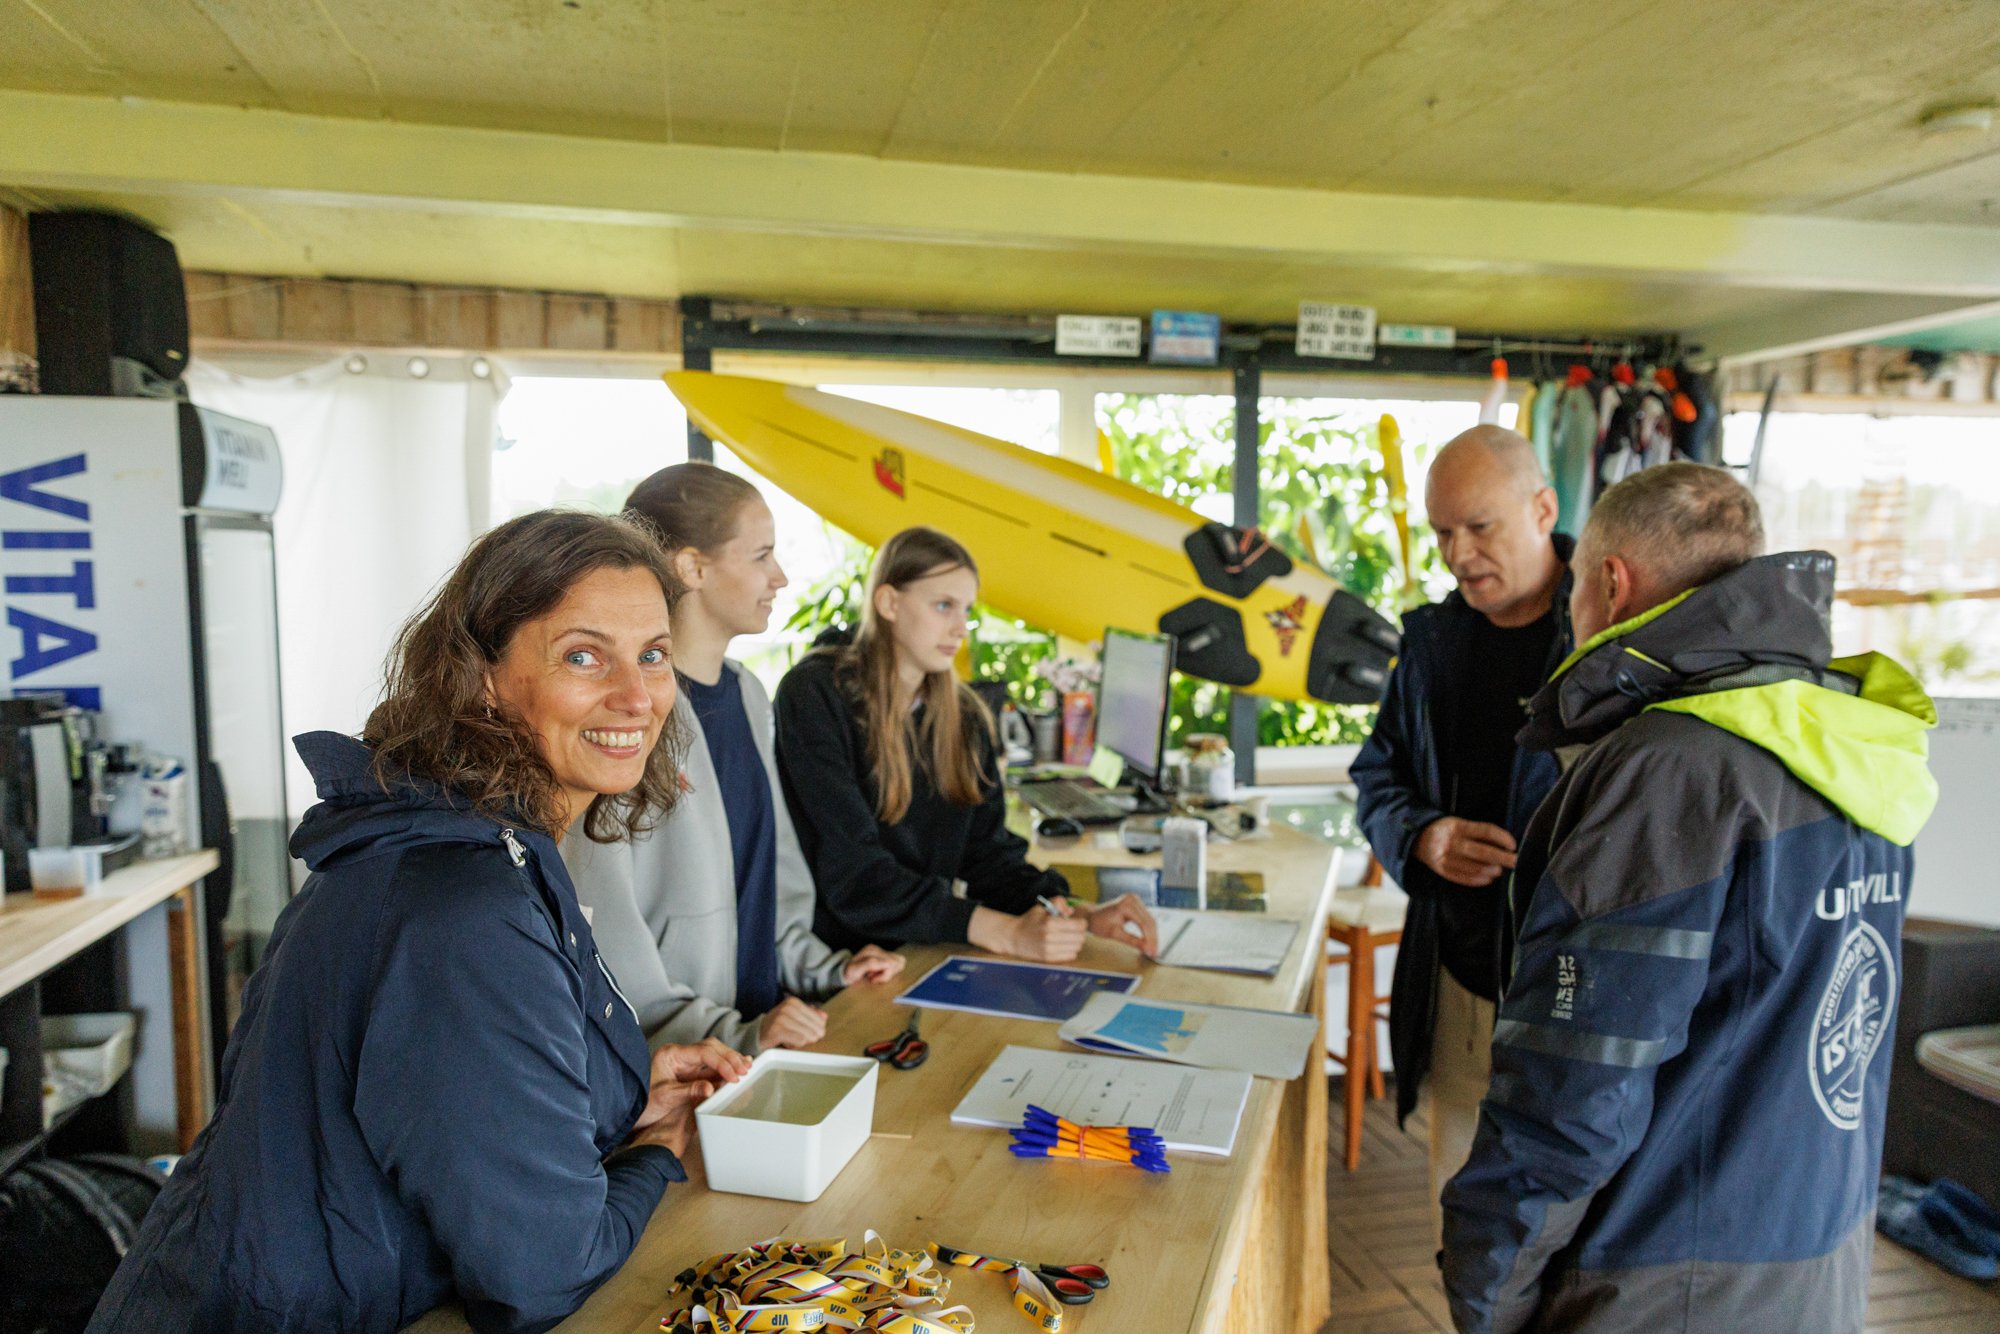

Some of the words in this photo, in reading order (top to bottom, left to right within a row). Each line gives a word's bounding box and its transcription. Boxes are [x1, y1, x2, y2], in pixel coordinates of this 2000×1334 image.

[865, 1263, 881, 1275] VIP
[829, 1303, 847, 1315] VIP
[1023, 1301, 1038, 1317] VIP
[716, 1317, 731, 1333] VIP
[771, 1314, 789, 1326] VIP
